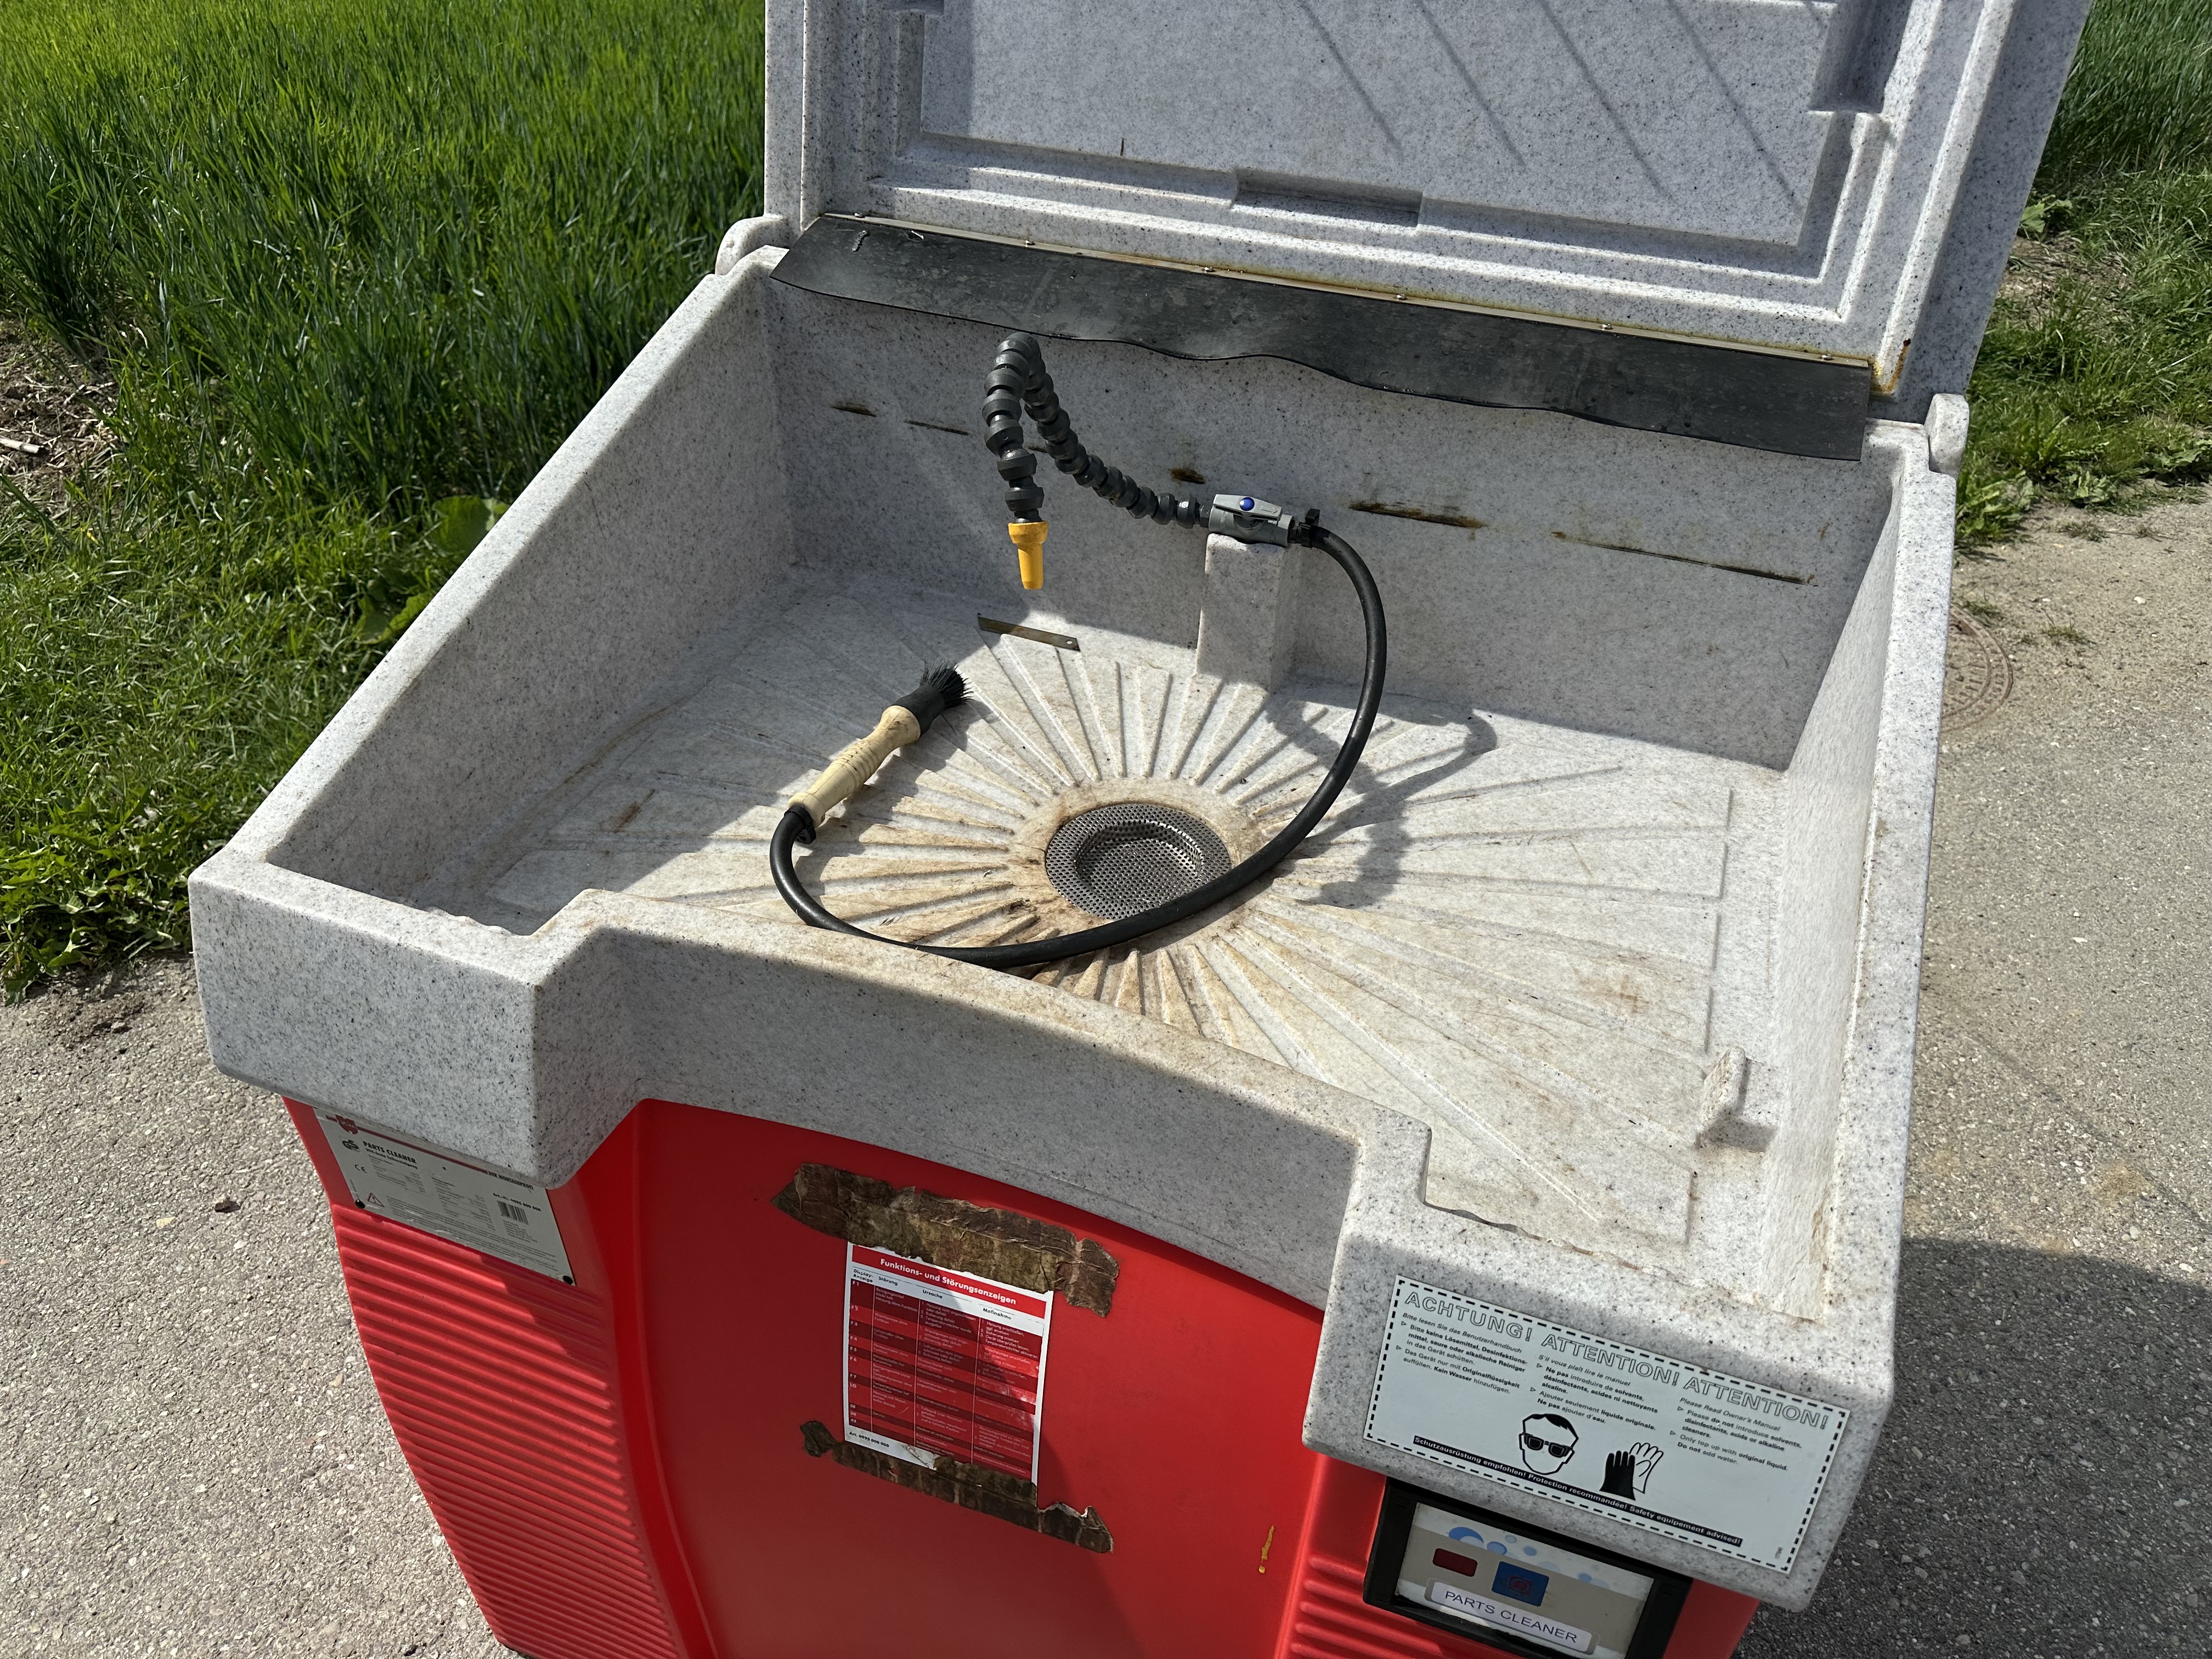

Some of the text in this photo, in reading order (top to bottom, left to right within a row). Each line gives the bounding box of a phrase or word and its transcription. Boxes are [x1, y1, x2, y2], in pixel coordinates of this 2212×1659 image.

[362, 1141, 416, 1164] PARTS CLEANER
[878, 1276, 898, 1285] Störung
[881, 1259, 1015, 1304] Funktions- und Störungsanzeigen
[922, 1289, 942, 1298] Ursache
[983, 1307, 1011, 1319] Maßnahme
[1404, 1291, 1532, 1341] ACHTUNG!
[1402, 1312, 1417, 1321] Bitte
[1418, 1317, 1435, 1326] lesen
[1462, 1331, 1521, 1353] Benutzerhandbuch
[1410, 1324, 1527, 1363] Bitte keine Lösemittel, Desinfektions-
[1408, 1333, 1427, 1342] mittel,
[1430, 1340, 1447, 1348] saure
[1465, 1351, 1497, 1363] alkalische
[1498, 1360, 1525, 1372] Reiniger
[1418, 1353, 1436, 1362] Gerät
[1462, 1367, 1519, 1388] Originalflüssigkeit
[1427, 1346, 1444, 1355] Gerät
[1446, 1353, 1474, 1364] schütten.
[1541, 1334, 1679, 1386] ATTENTION!
[1403, 1357, 1430, 1368] auffüllen.
[1449, 1370, 1471, 1381] Wasser
[1473, 1378, 1509, 1393] hinzufügen.
[1570, 1374, 1602, 1387] introduire
[1615, 1389, 1643, 1400] solvants,
[1605, 1376, 1630, 1386] manuel
[1539, 1391, 1655, 1430] Ajouter seulement liquide originale.
[1543, 1374, 1588, 1392] désinfectants,
[1590, 1390, 1611, 1398] acides
[1622, 1399, 1657, 1413] nettoyants
[1683, 1376, 1828, 1430] ATTENTION!
[1561, 1407, 1584, 1416] ajouter
[1586, 1414, 1605, 1423] d'eau.
[1679, 1397, 1780, 1430] Please Read Owner's Manual
[1682, 1426, 1710, 1437] cleaners.
[1687, 1409, 1709, 1420] Please
[1735, 1424, 1768, 1438] introduce
[1770, 1436, 1801, 1448] solvents,
[1680, 1434, 1696, 1443] Only
[1739, 1453, 1765, 1464] original
[1767, 1460, 1787, 1470] liquid.
[1684, 1418, 1728, 1435] disinfectants,
[1758, 1440, 1784, 1451] alkaline
[1717, 1455, 1736, 1463] water.
[1414, 1436, 1741, 1545] Schutzausrüstung empfohlen! Protection recommandée! Safety equipement advised!
[1444, 1590, 1577, 1643] PARTS CLEANER
